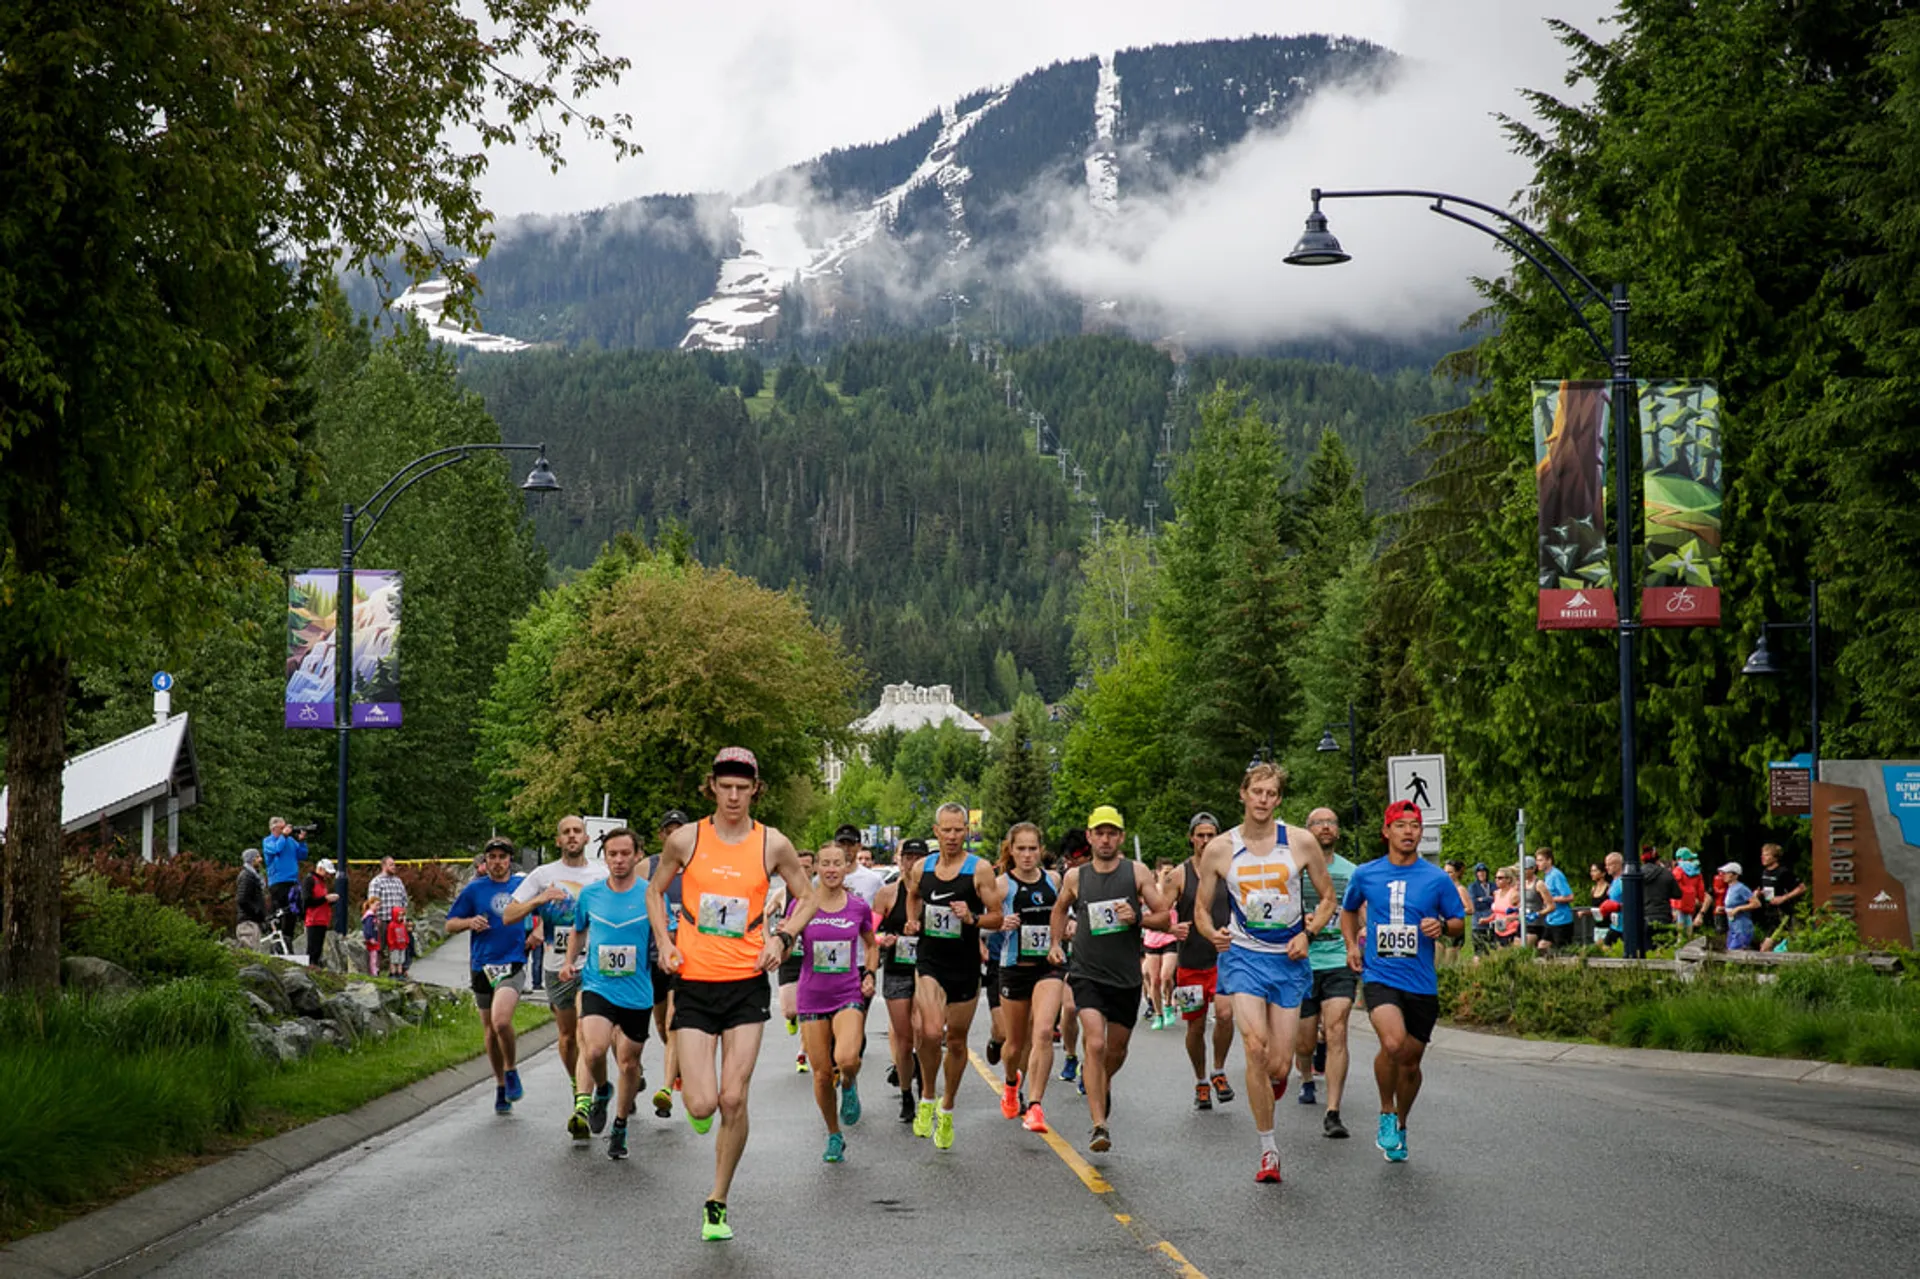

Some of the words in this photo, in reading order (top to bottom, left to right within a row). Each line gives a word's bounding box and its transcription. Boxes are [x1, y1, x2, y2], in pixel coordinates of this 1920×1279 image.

[157, 675, 166, 688] 4
[1828, 802, 1855, 883] VILLAGE
[718, 905, 728, 925] 1
[1105, 908, 1114, 924] 3
[1263, 902, 1272, 919] 2
[933, 912, 949, 929] 31
[1031, 932, 1047, 948] 37
[1379, 932, 1416, 949] 2056
[608, 952, 626, 968] 30
[827, 949, 837, 964] 4
